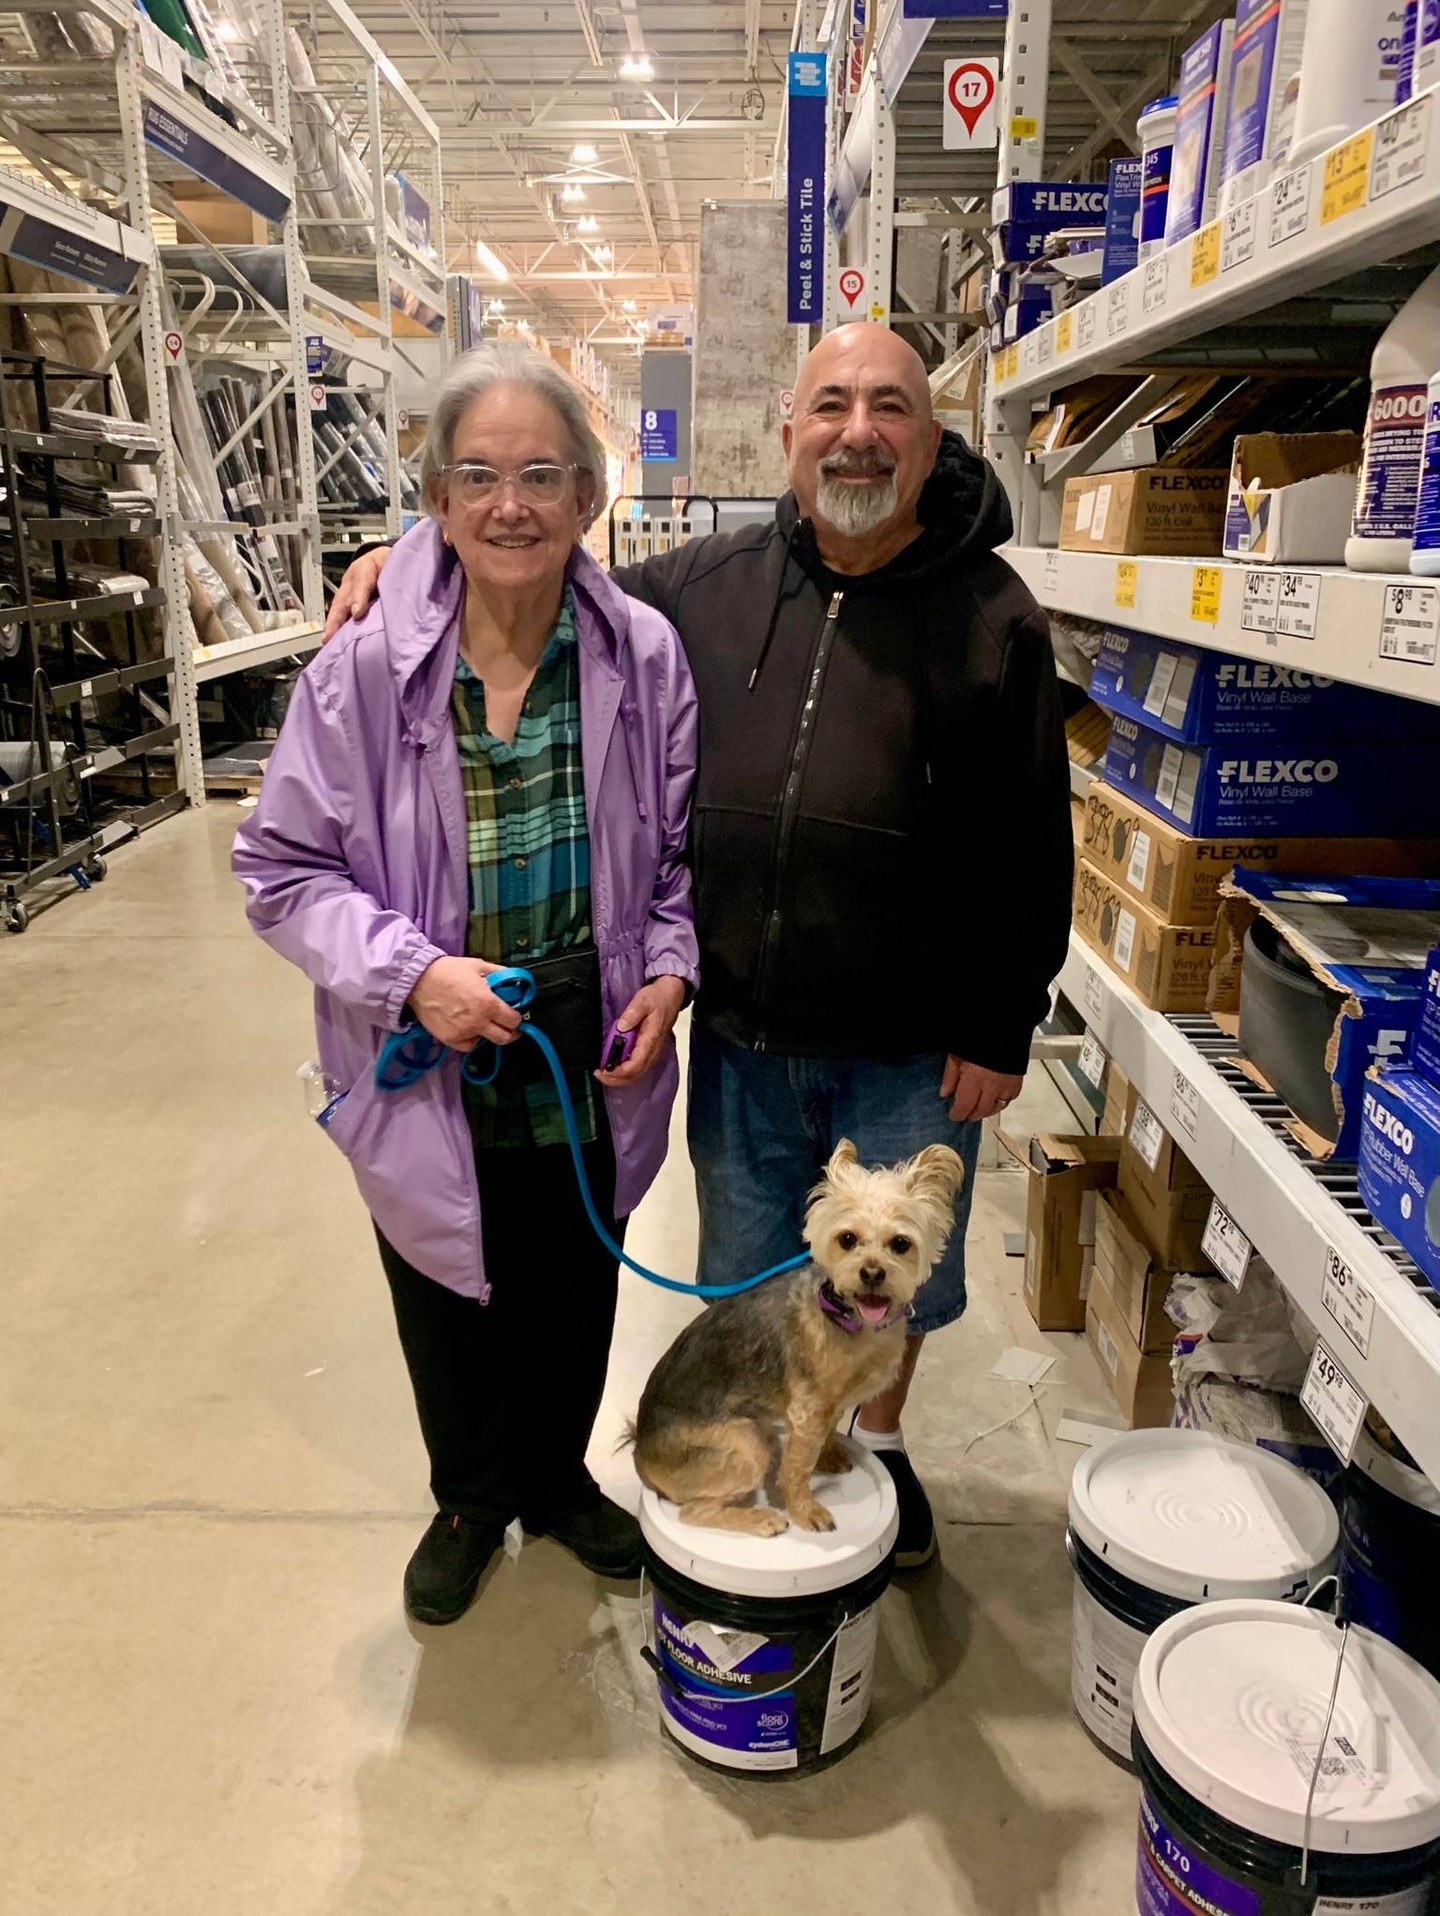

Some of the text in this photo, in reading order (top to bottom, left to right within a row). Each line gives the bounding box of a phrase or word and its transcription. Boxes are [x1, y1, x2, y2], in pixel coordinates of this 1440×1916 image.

[962, 82, 981, 97] 17
[1115, 163, 1143, 174] FLEX
[799, 177, 814, 310] Peel & Stick Tile
[846, 279, 857, 289] 15
[1374, 394, 1428, 421] 6000
[645, 410, 658, 431] 8
[1149, 475, 1226, 491] FLEXCO
[1147, 502, 1177, 515] Vinyl
[1179, 502, 1206, 514] Wall
[1215, 664, 1335, 688] FLEXCO
[1217, 690, 1311, 705] Vinyl Wall Base
[1216, 759, 1339, 783] FLEXCO
[1219, 785, 1313, 798] Vinyl Wall Base
[1196, 845, 1278, 860] FLEXCO
[1175, 932, 1212, 947] FLE
[1172, 958, 1204, 971] Vinyl
[1363, 1092, 1413, 1155] FLEXCO
[1393, 1153, 1408, 1181] Wall
[662, 1612, 696, 1649] HENRY
[667, 1639, 695, 1668] FLOOR
[696, 1661, 753, 1685] ADHESIVE
[1165, 1839, 1191, 1873] 170
[1318, 1899, 1380, 1910] HENRY 170
